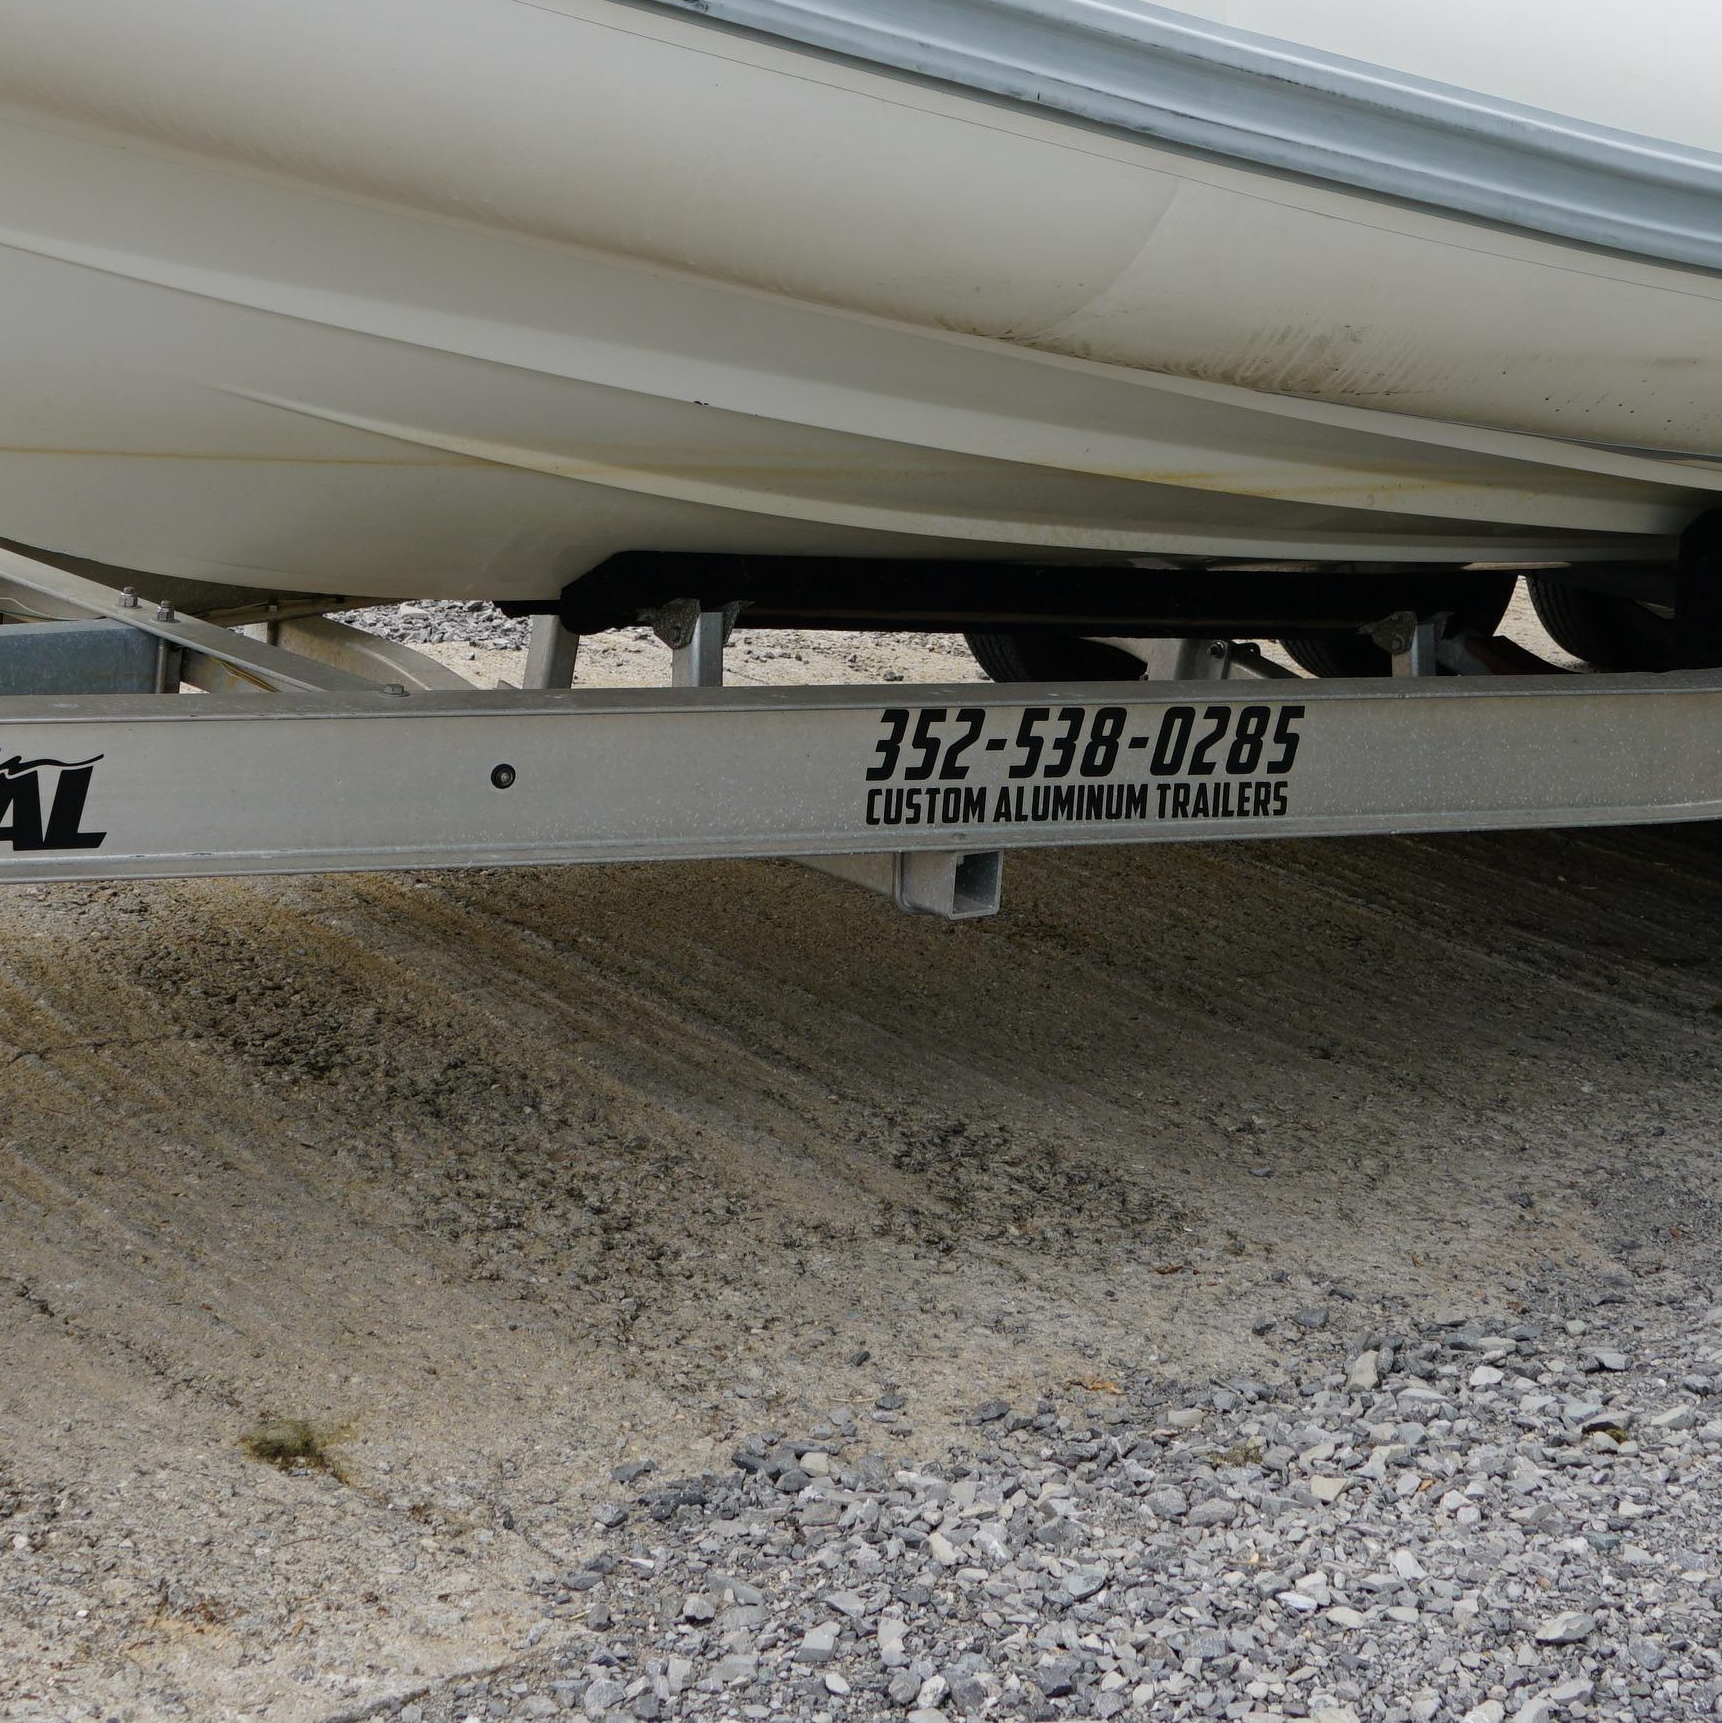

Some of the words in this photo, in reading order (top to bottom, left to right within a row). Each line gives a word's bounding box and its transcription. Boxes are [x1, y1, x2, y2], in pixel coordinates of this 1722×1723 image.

[866, 705, 1305, 781] 352-538-0285
[866, 786, 986, 826] CUSTOM
[993, 783, 1148, 823] ALUMINUM
[1156, 780, 1288, 819] TRAILERS
